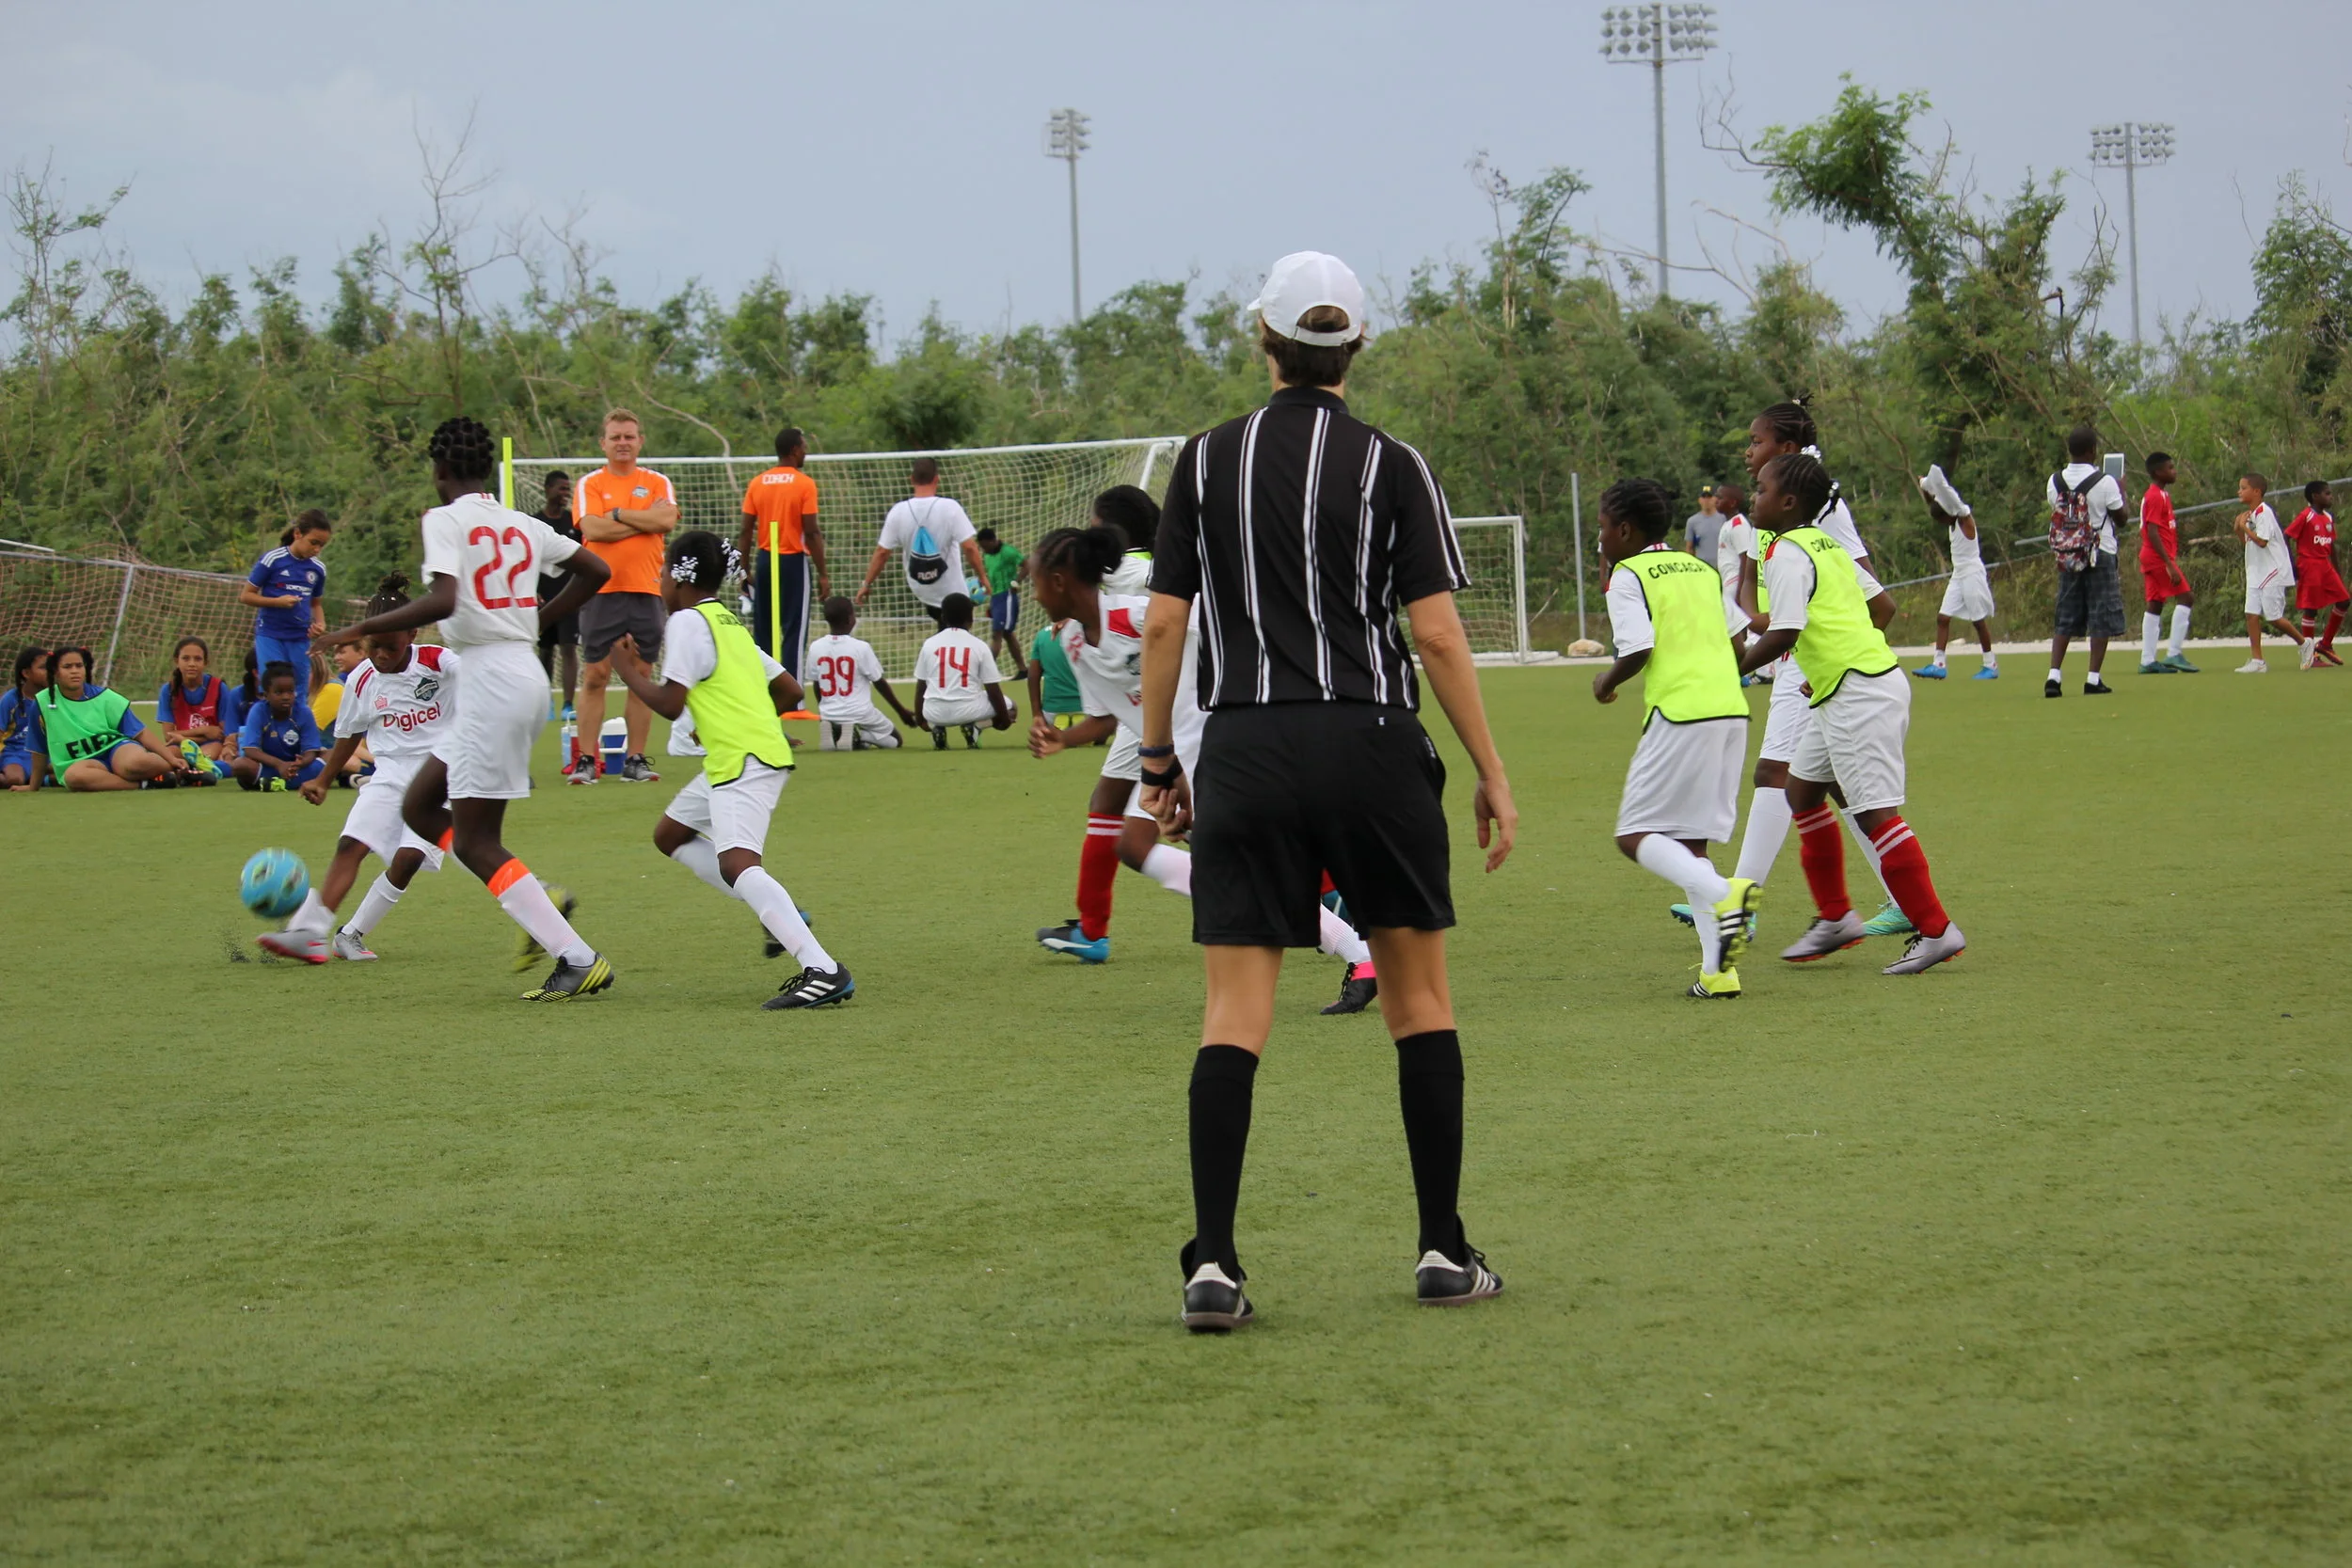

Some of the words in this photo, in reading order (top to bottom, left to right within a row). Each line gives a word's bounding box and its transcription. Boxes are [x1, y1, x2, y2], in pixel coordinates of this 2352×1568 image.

[762, 474, 795, 484] COACH
[469, 526, 538, 610] 22
[917, 568, 938, 580] FLOW
[1648, 562, 1708, 579] CONCACA
[817, 656, 855, 697] 39
[933, 646, 971, 688] 14
[383, 701, 441, 732] Digicel
